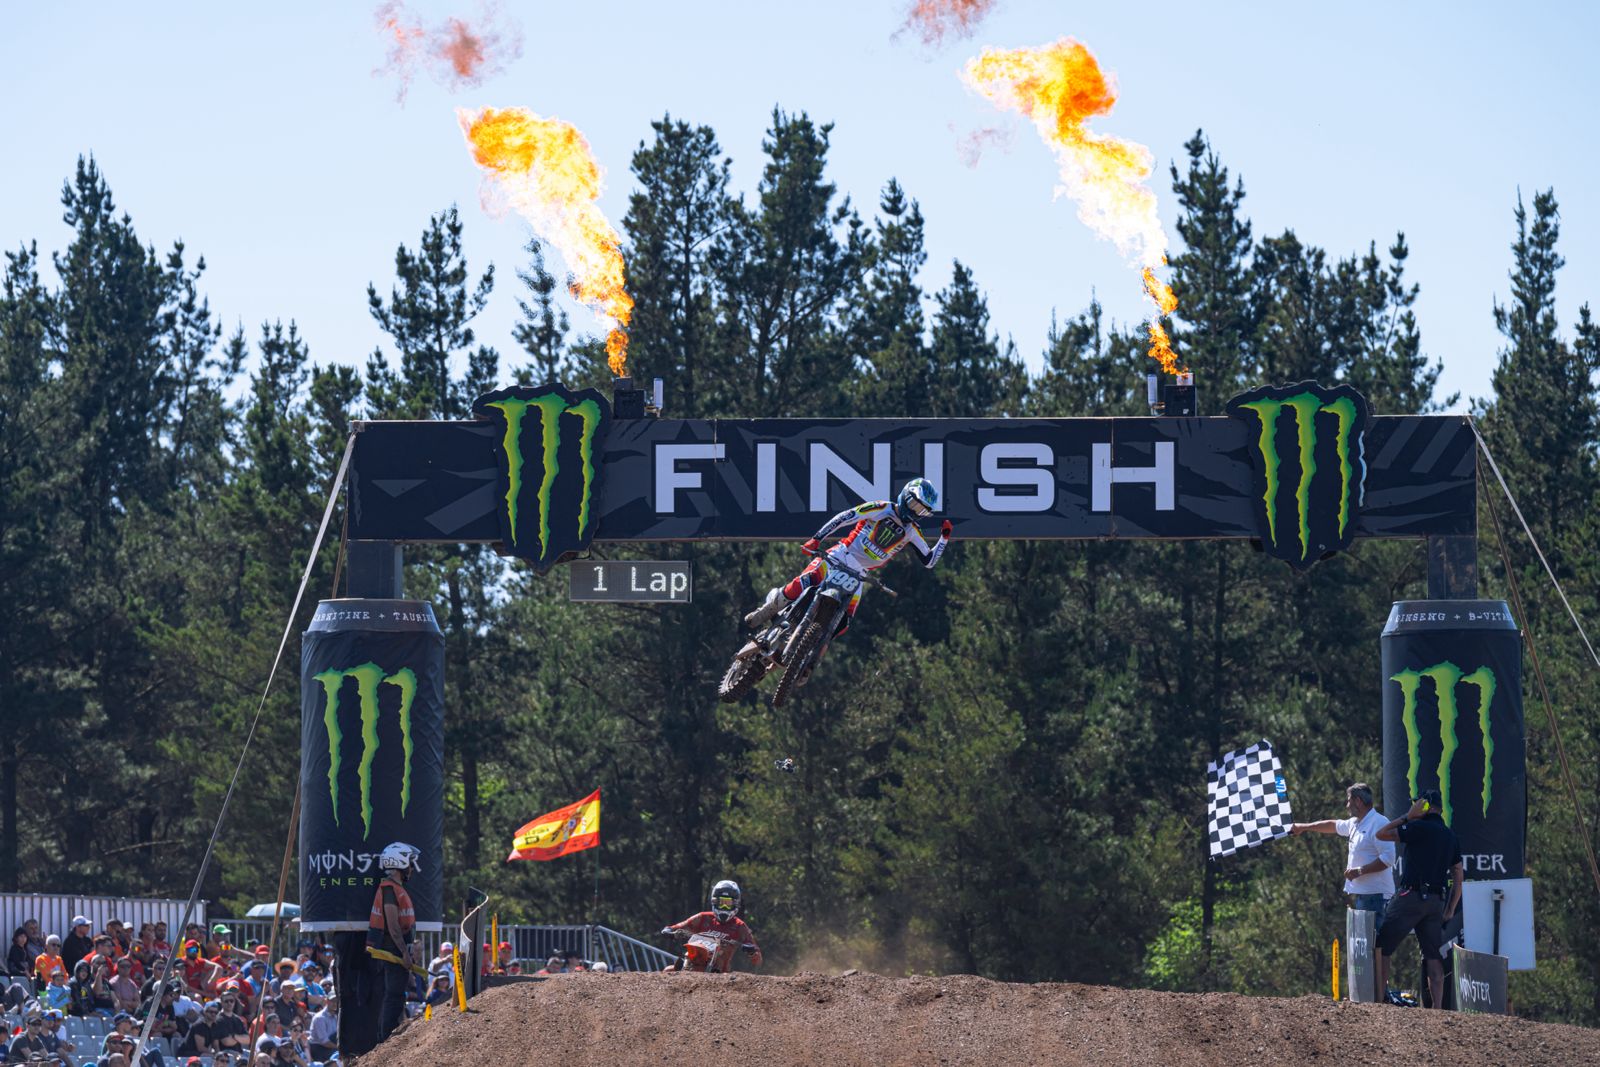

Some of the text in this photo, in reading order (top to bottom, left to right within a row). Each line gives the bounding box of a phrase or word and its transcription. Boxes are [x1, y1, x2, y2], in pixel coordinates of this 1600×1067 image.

[653, 441, 1177, 513] FINISH
[593, 565, 688, 599] 1 Lap
